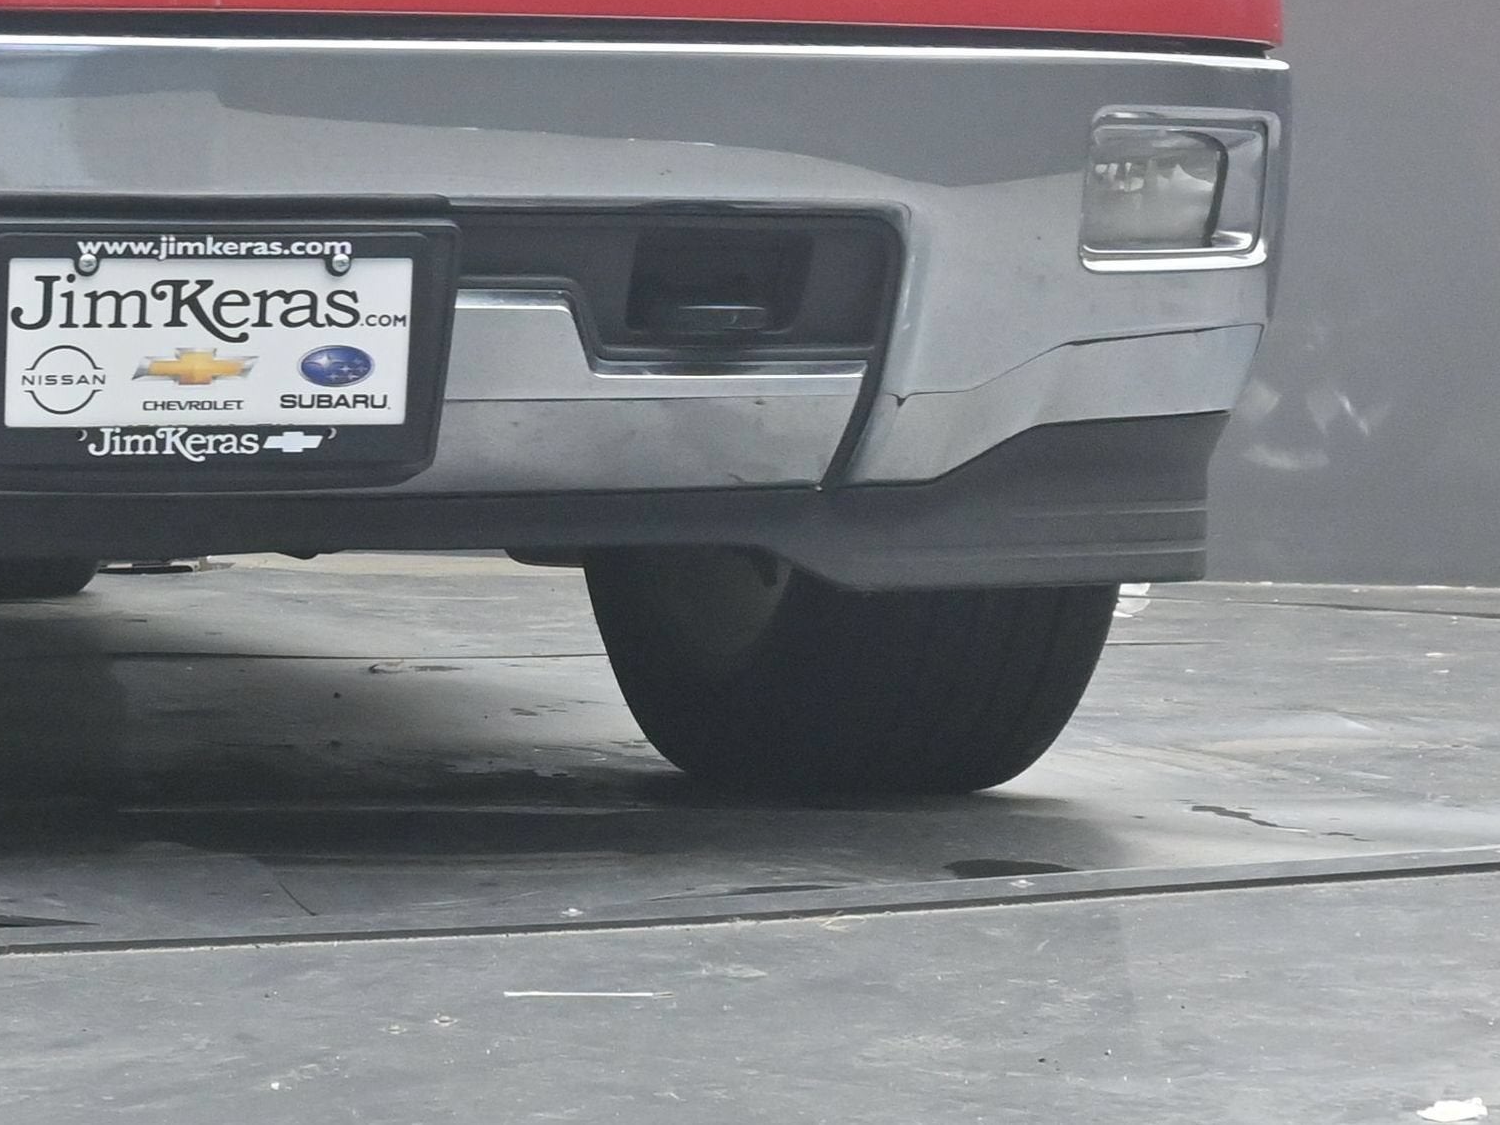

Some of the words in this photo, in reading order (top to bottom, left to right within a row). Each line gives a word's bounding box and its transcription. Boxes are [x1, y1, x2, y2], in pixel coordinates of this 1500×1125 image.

[77, 234, 353, 261] www.jimkeras.com
[21, 374, 107, 387] NISSAN
[141, 399, 245, 412] CHEVROLET
[279, 393, 388, 410] SUBARU
[87, 427, 260, 463] JimKeras
